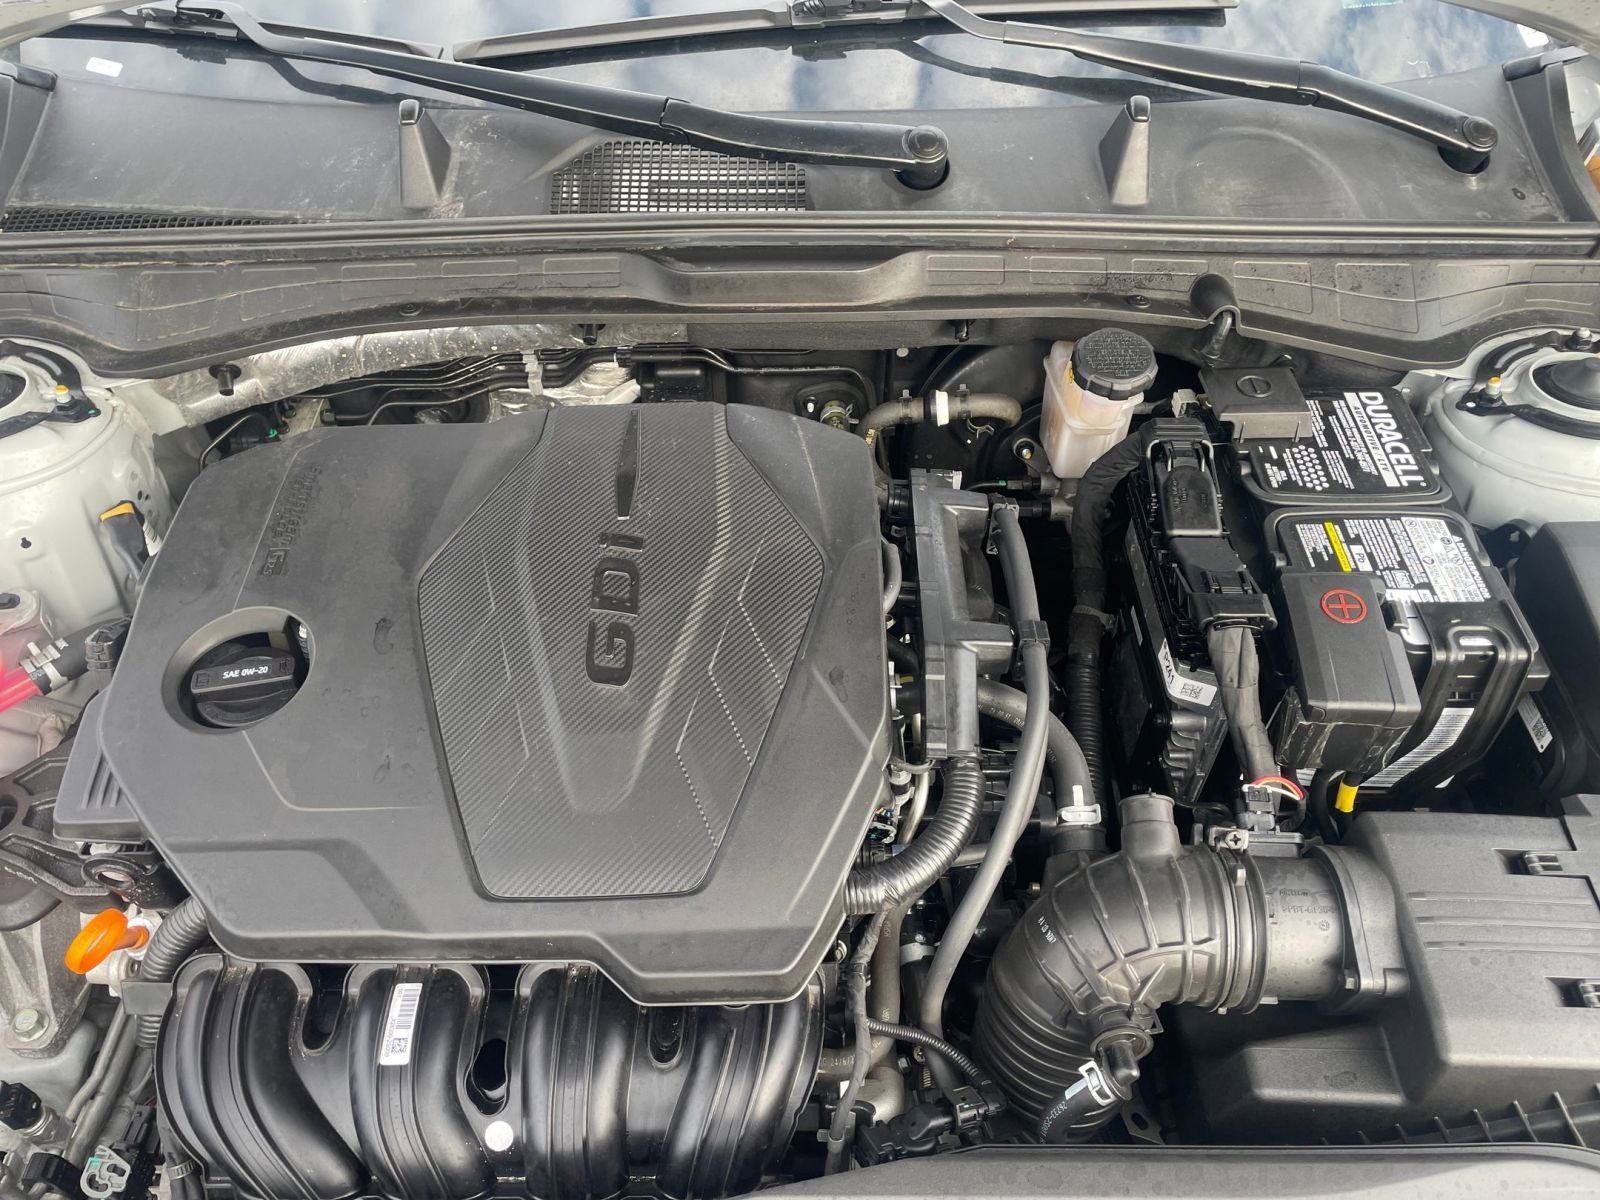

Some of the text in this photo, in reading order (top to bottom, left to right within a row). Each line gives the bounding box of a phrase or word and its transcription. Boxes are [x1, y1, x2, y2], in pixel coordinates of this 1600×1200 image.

[1353, 405, 1380, 451] AUTOMOTIVE
[1358, 391, 1424, 487] DURACELL
[222, 665, 269, 680] SAE 0W-20
